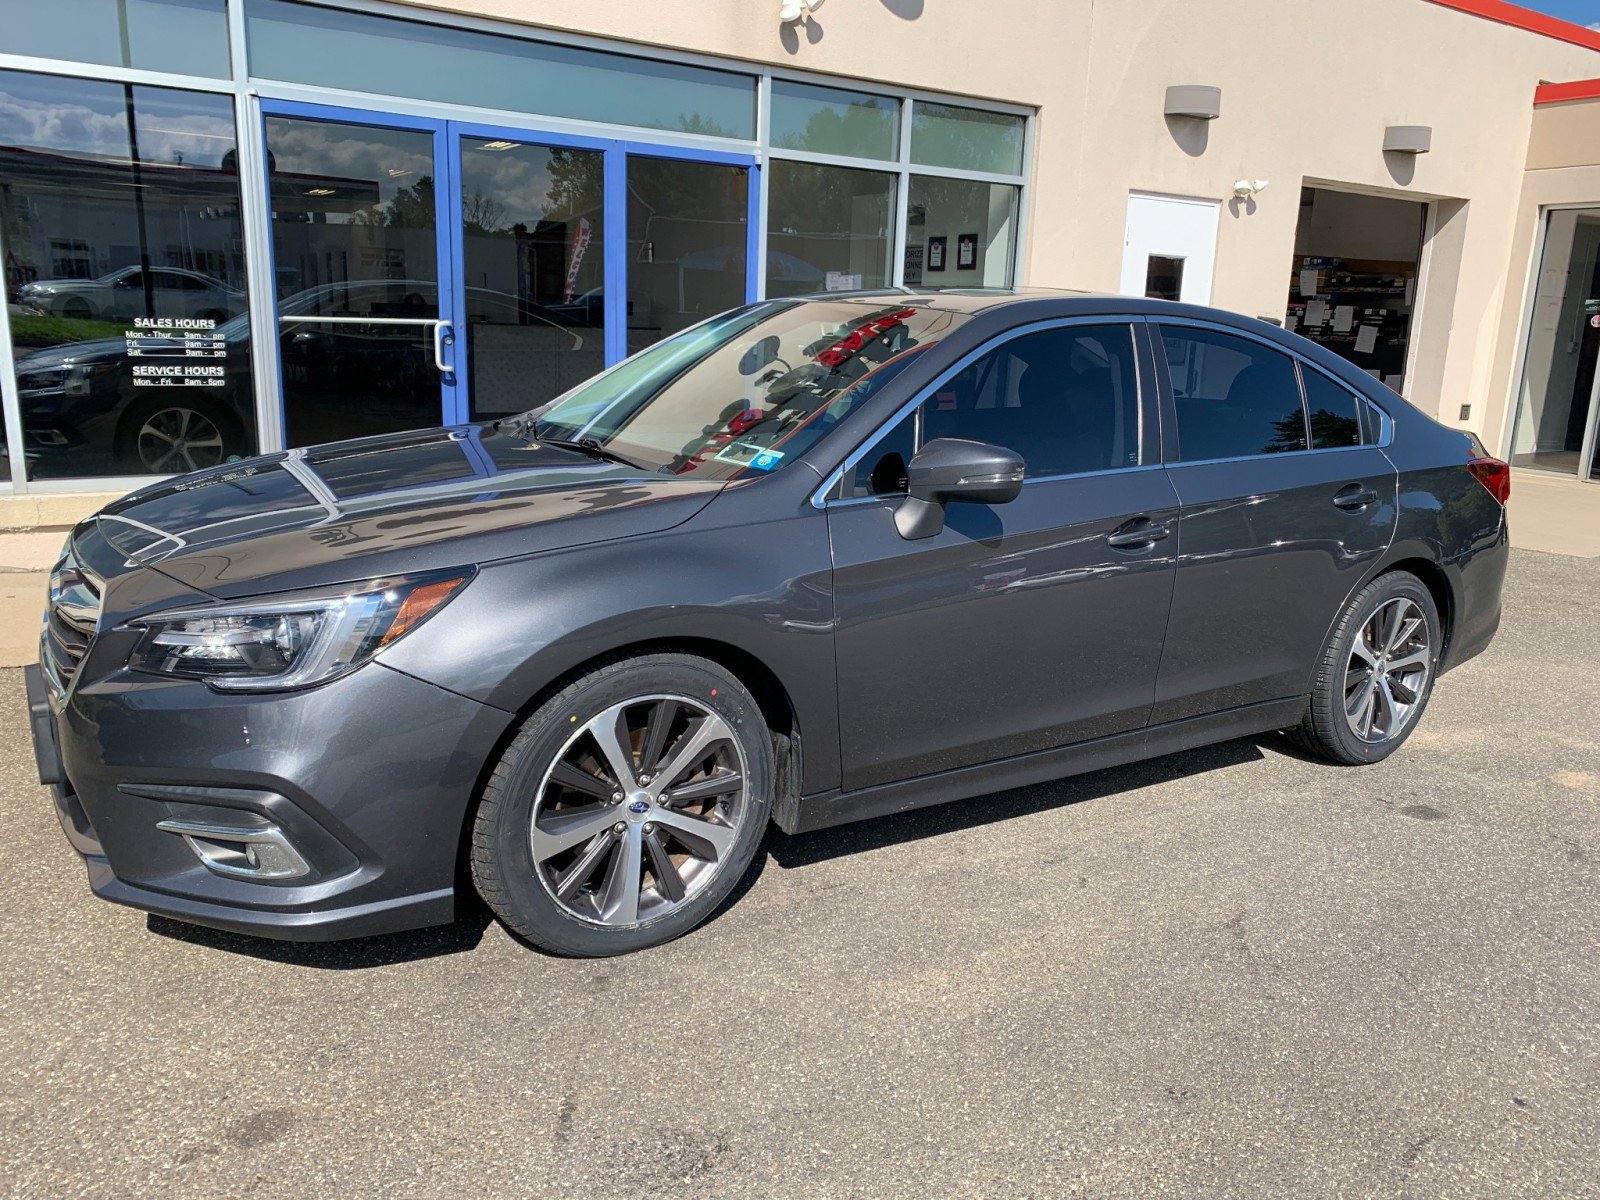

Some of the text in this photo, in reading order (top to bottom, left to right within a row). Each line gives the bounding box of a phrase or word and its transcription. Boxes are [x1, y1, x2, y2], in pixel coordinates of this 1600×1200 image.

[134, 317, 215, 329] SALES HOURS
[125, 330, 145, 338] Mon.
[152, 330, 173, 339] Thur.
[213, 333, 225, 341] pm
[127, 348, 144, 356] Sat.
[185, 349, 203, 357] 9am
[132, 366, 224, 376] SERVICE HOURS
[133, 378, 154, 386] Mon.
[160, 378, 173, 386] Fri.
[184, 378, 202, 386] 8am
[208, 378, 225, 386] 6pm
